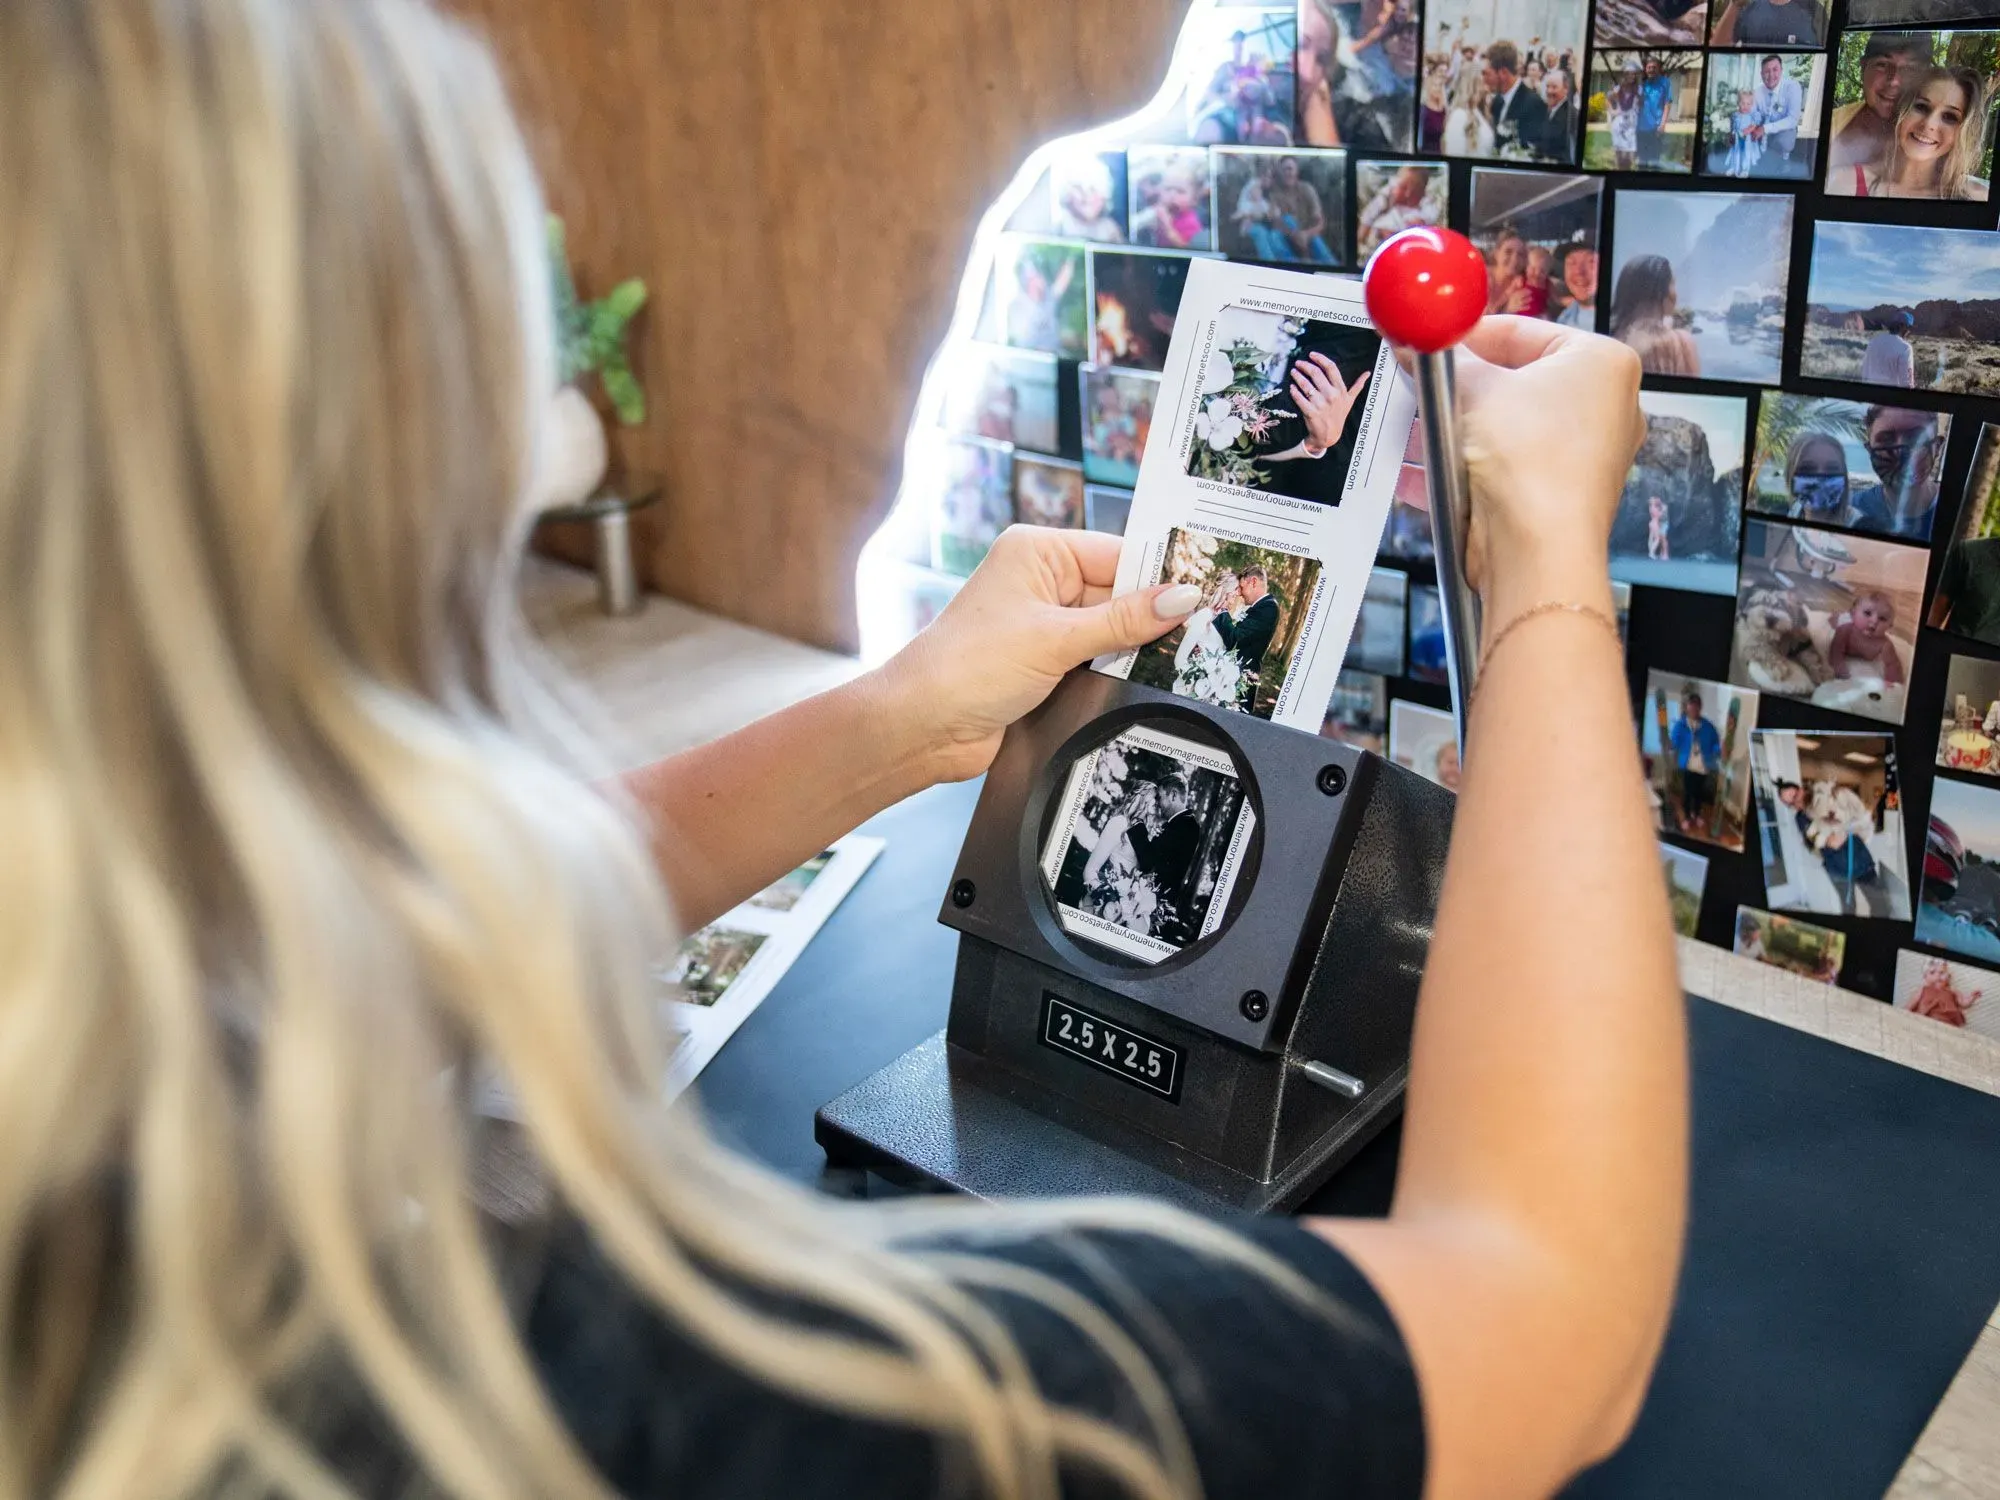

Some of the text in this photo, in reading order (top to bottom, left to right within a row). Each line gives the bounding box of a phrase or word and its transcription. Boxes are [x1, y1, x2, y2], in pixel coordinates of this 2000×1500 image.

[1239, 296, 1371, 325] www.memorymagnetsco.com
[1179, 319, 1217, 459] www.memorymagnetsco.com
[1346, 346, 1390, 491] www.memorymagnetsco.com
[1196, 480, 1323, 514] www.memorymagnetsco.com
[1186, 520, 1310, 555] www.memorymagnetsco.com
[1276, 576, 1328, 716] www.memorymagnetsco.com
[1058, 1013, 1162, 1078] 2.5 X 2.5
